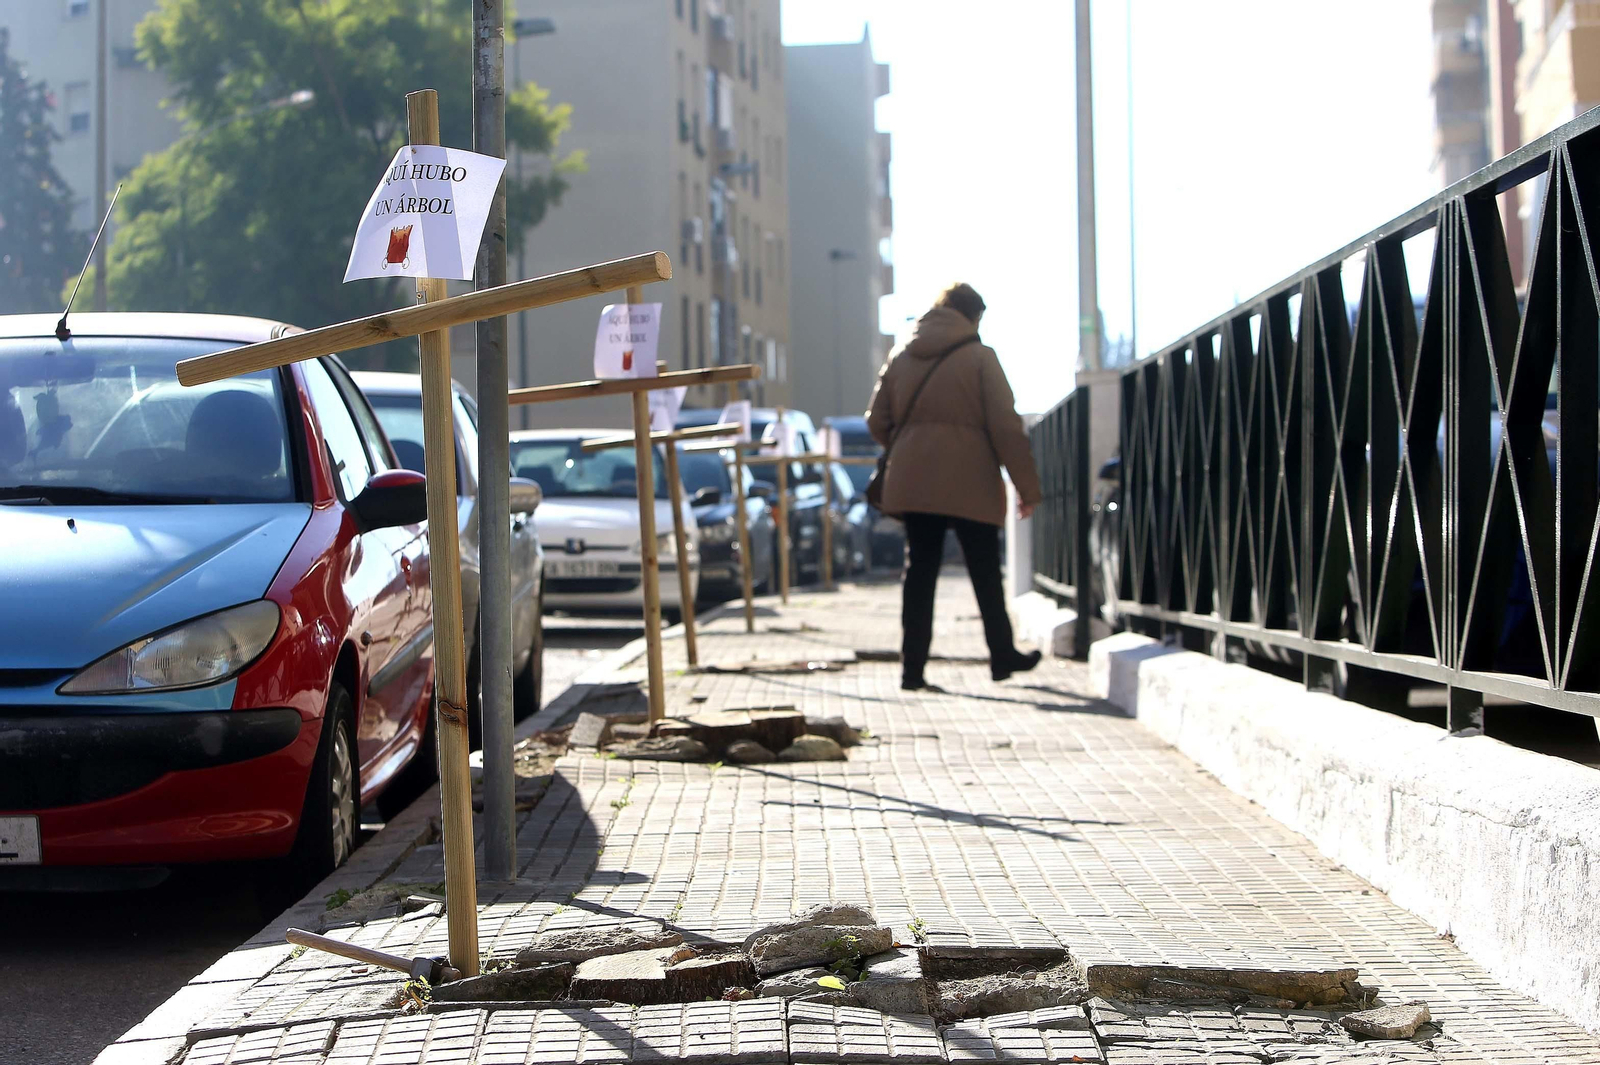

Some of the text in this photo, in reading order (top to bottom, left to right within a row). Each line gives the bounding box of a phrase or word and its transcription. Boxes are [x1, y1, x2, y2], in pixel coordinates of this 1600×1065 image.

[383, 160, 467, 186] QUÍ HUBO
[375, 193, 453, 216] UN ÁRBOL
